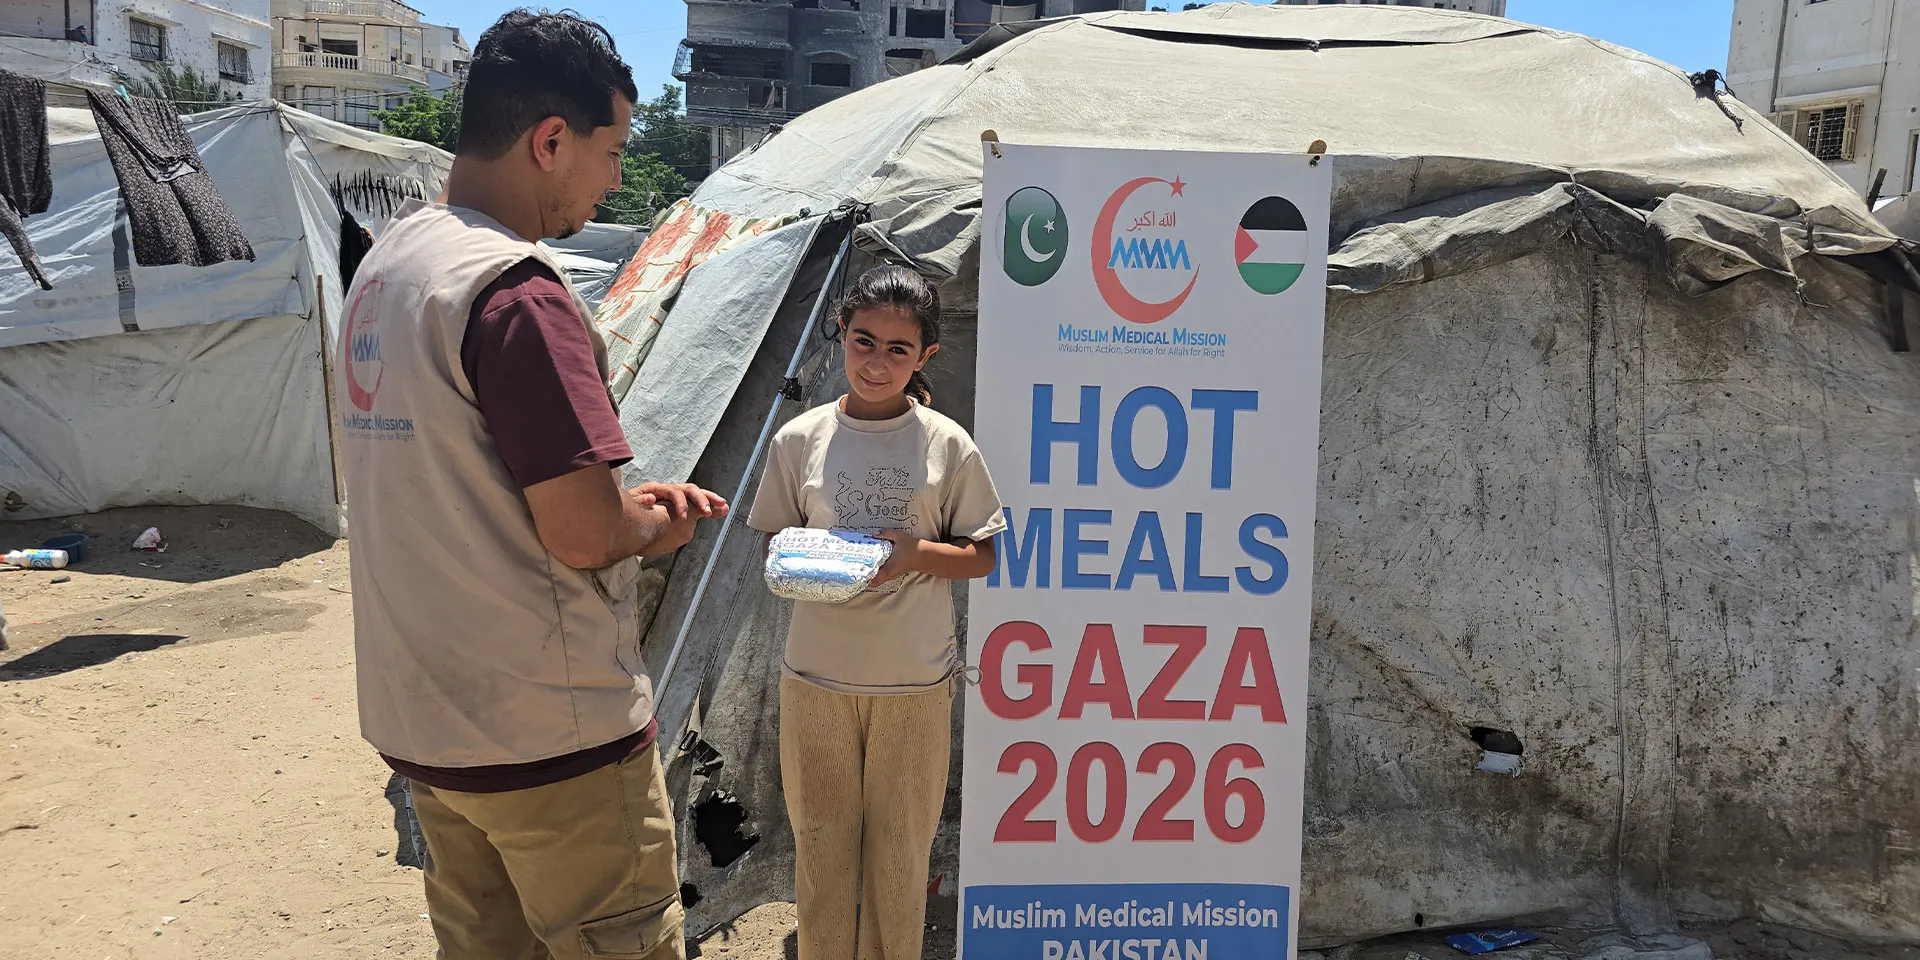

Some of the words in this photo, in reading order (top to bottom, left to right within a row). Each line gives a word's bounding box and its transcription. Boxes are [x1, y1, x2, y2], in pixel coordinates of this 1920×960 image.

[1158, 208, 1176, 228] الله
[1107, 236, 1191, 270] MMM
[1058, 323, 1108, 342] MUSLIM
[1112, 325, 1169, 344] MEDICAL
[1173, 327, 1226, 346] MISSION
[1095, 344, 1123, 355] Action,
[1124, 345, 1154, 355] Service
[1155, 346, 1167, 355] for
[1168, 346, 1189, 356] Allah
[1190, 347, 1202, 356] for
[1203, 348, 1225, 358] Right
[375, 413, 414, 431] MISSION
[1030, 383, 1258, 490] HOT
[784, 542, 830, 550] GAZA
[987, 506, 1289, 595] MEALS
[979, 620, 1288, 724] GAZA
[993, 741, 1265, 843] 2026
[972, 901, 1066, 929] Muslim
[1075, 900, 1174, 928] Medical
[1182, 899, 1278, 928] Mission
[1042, 938, 1208, 960] PAKISTAN
